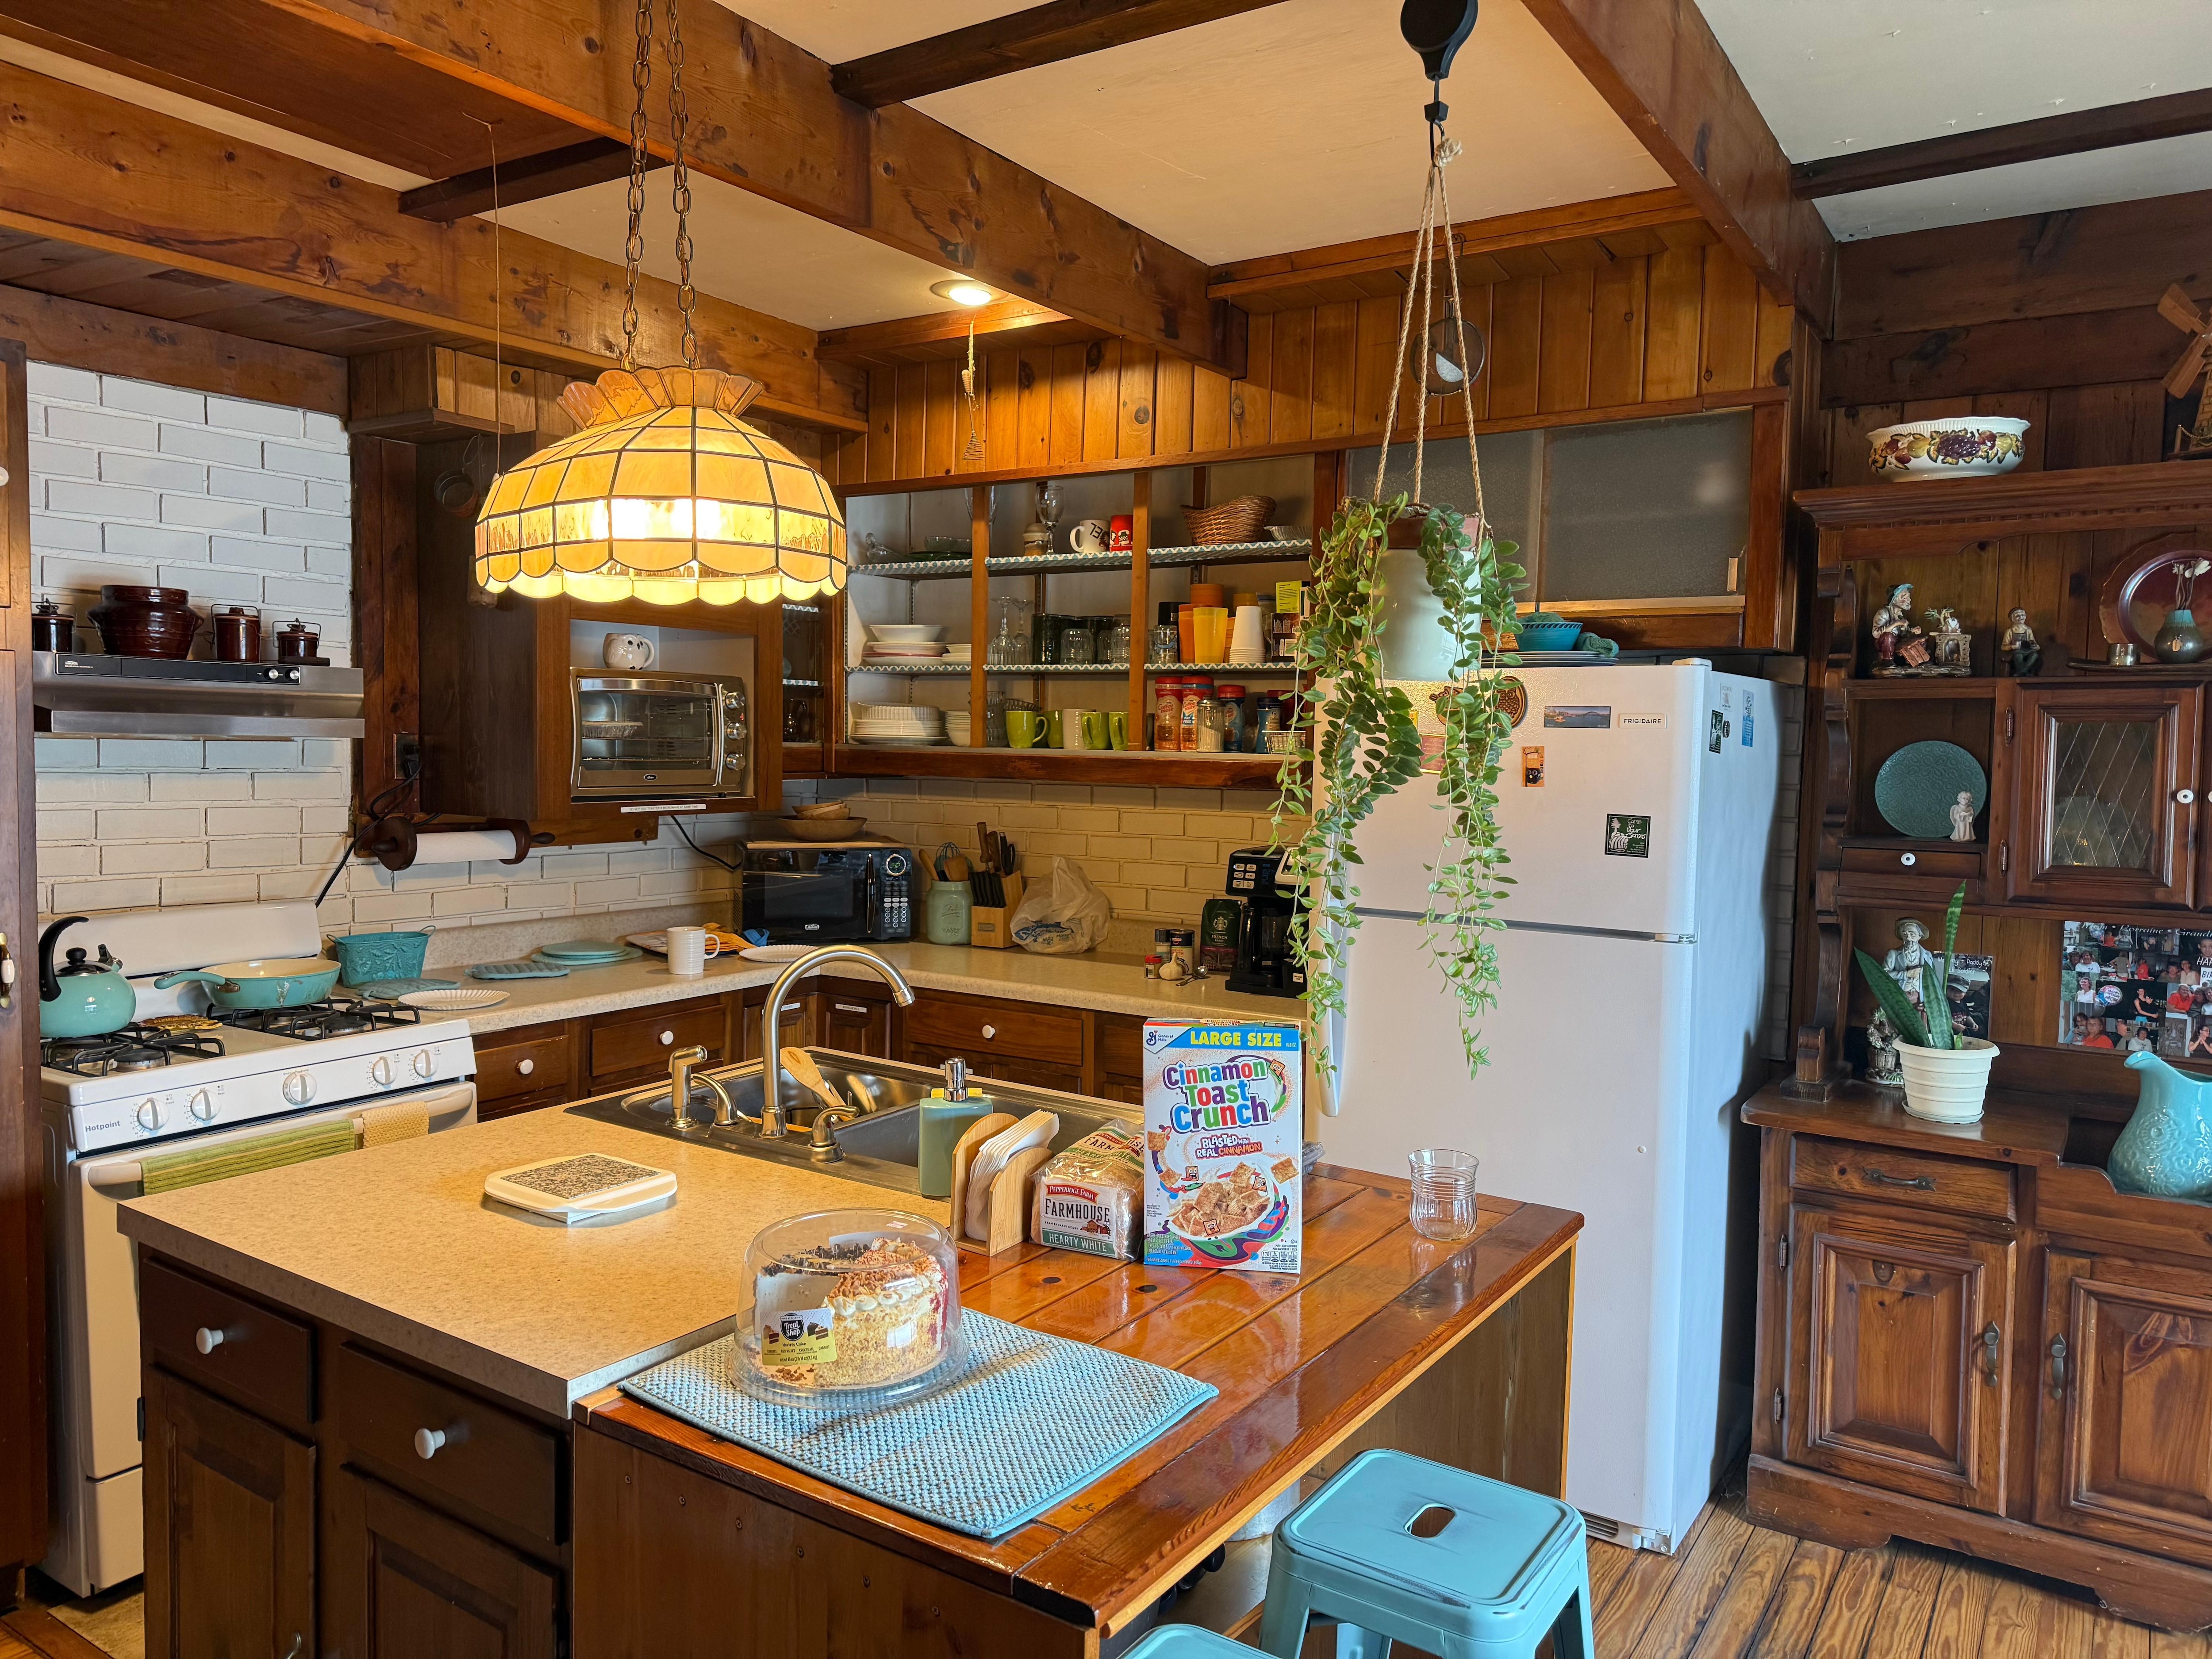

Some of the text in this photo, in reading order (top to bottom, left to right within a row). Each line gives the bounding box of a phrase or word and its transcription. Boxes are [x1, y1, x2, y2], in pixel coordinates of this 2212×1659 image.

[2120, 925, 2163, 934] Lorraine
[1190, 1031, 1281, 1047] LARGE SIZE
[1167, 1060, 1266, 1086] Cinnamon
[1185, 1080, 1249, 1106] Toast
[1174, 1096, 1269, 1130] Crunch
[85, 1120, 120, 1132] Hotpoint
[1202, 1135, 1238, 1149] BLASTED
[1197, 1143, 1261, 1158] REAL CINNAMON
[1050, 1186, 1093, 1199] PEPPERIDGE FARM
[1045, 1198, 1110, 1223] FARMHOUSE
[1049, 1233, 1107, 1252] HEARTY WHITE
[784, 1321, 800, 1329] Treat
[786, 1328, 800, 1336] Shop
